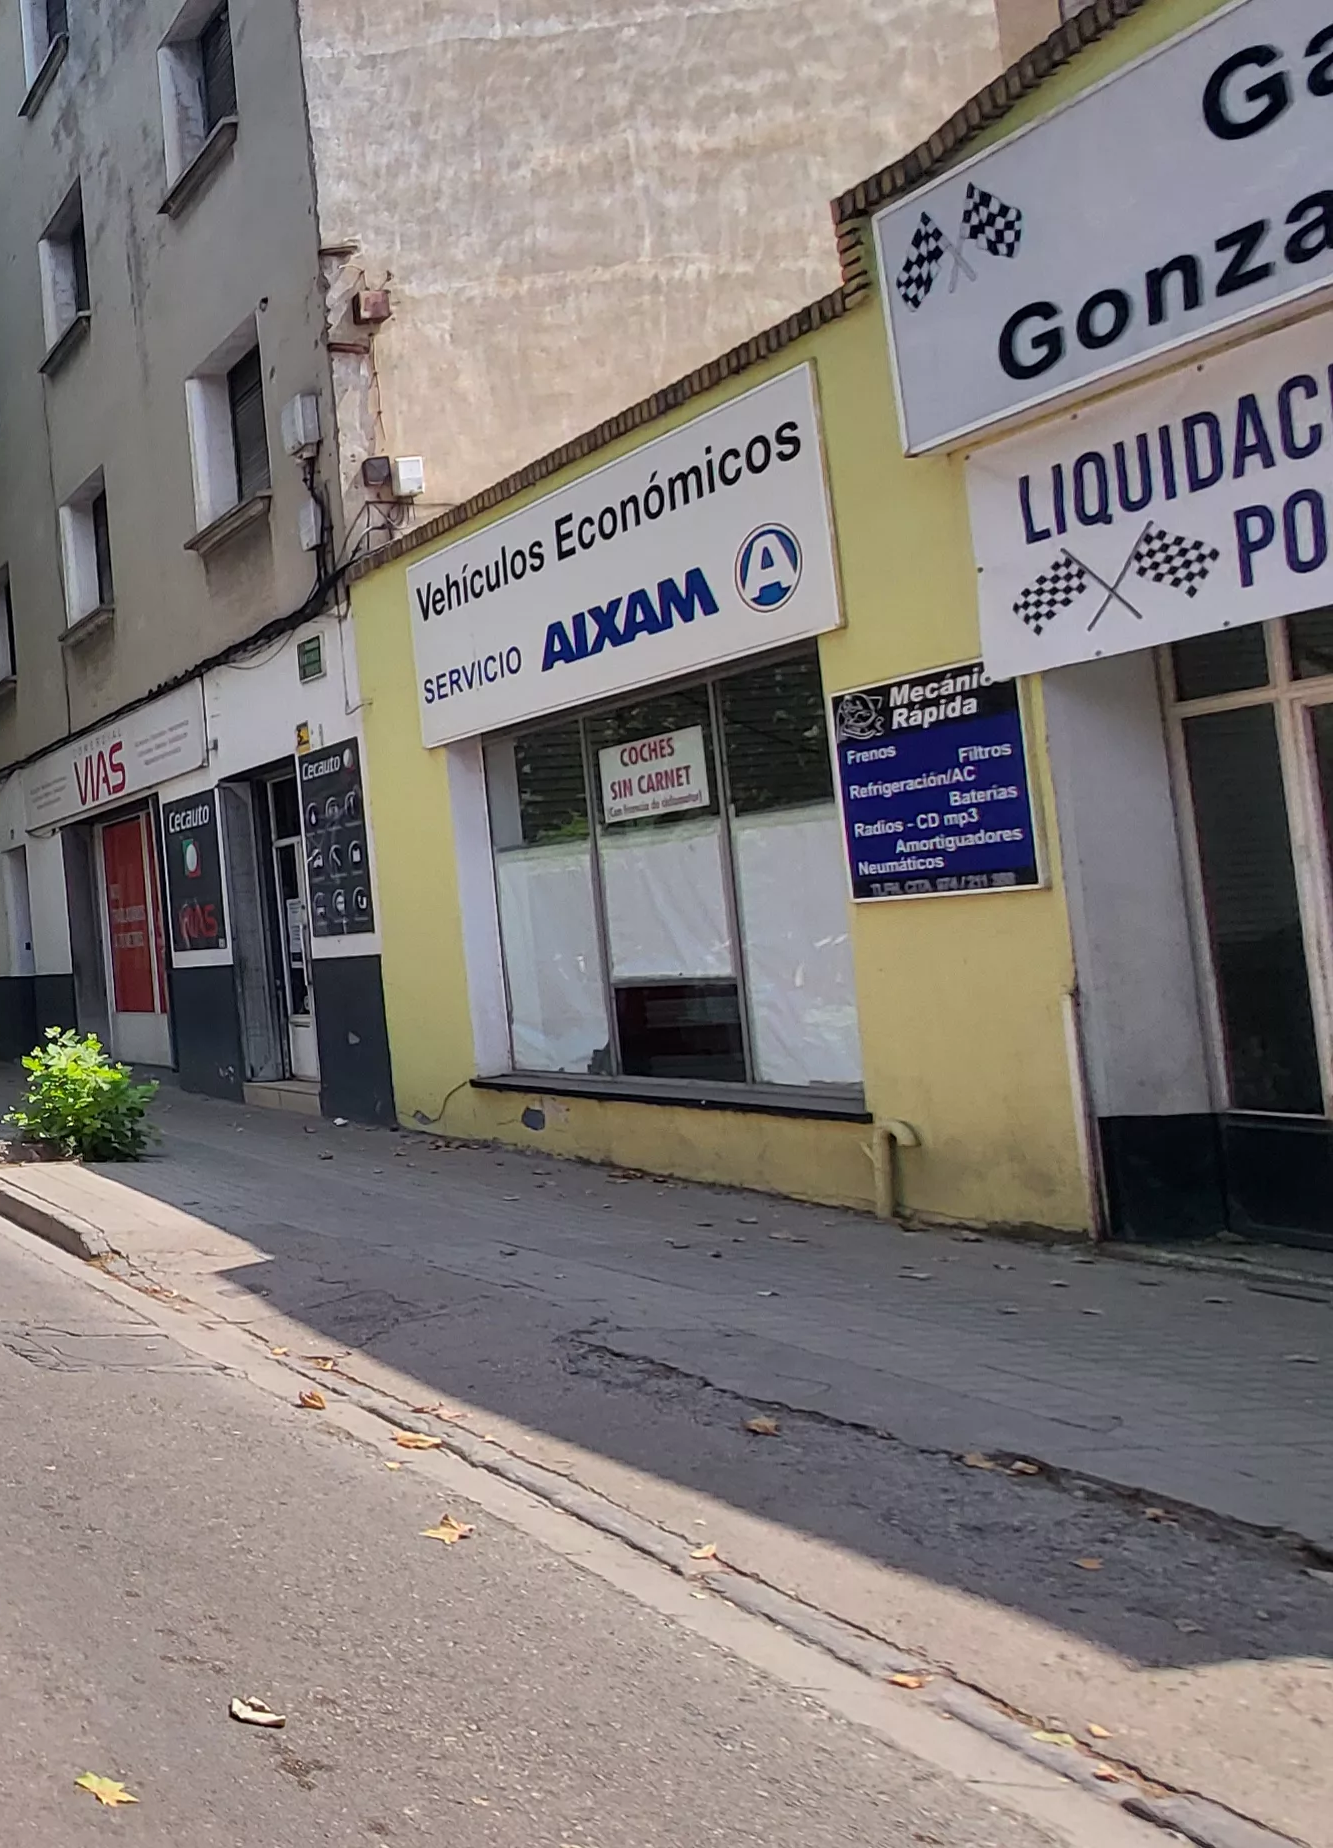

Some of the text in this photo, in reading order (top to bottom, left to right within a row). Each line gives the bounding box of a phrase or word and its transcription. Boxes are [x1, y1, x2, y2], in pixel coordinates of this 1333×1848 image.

[998, 189, 1333, 380] Gonza
[1018, 364, 1333, 545] LIQUIDAC
[416, 421, 801, 622] Vehículos Económicos
[1234, 488, 1328, 588] PO
[424, 646, 522, 704] SERVICIO
[541, 567, 720, 672] AIXAM
[889, 666, 1010, 708] Mecánic
[891, 695, 978, 730] Rápida
[302, 756, 341, 781] Cecauto
[620, 737, 675, 767] COCHES
[846, 743, 1012, 765] Frenos Filtros
[73, 741, 126, 806] VIAS
[610, 778, 634, 801] SIN
[638, 765, 691, 794] CARNET
[849, 766, 977, 800] Refrigeración/AC
[169, 804, 210, 834] Cecauto
[854, 820, 904, 838] Radios
[916, 813, 940, 829] CD
[944, 808, 979, 828] mp3
[896, 828, 1024, 853] Amortiguadores
[858, 856, 945, 876] Neumáticos
